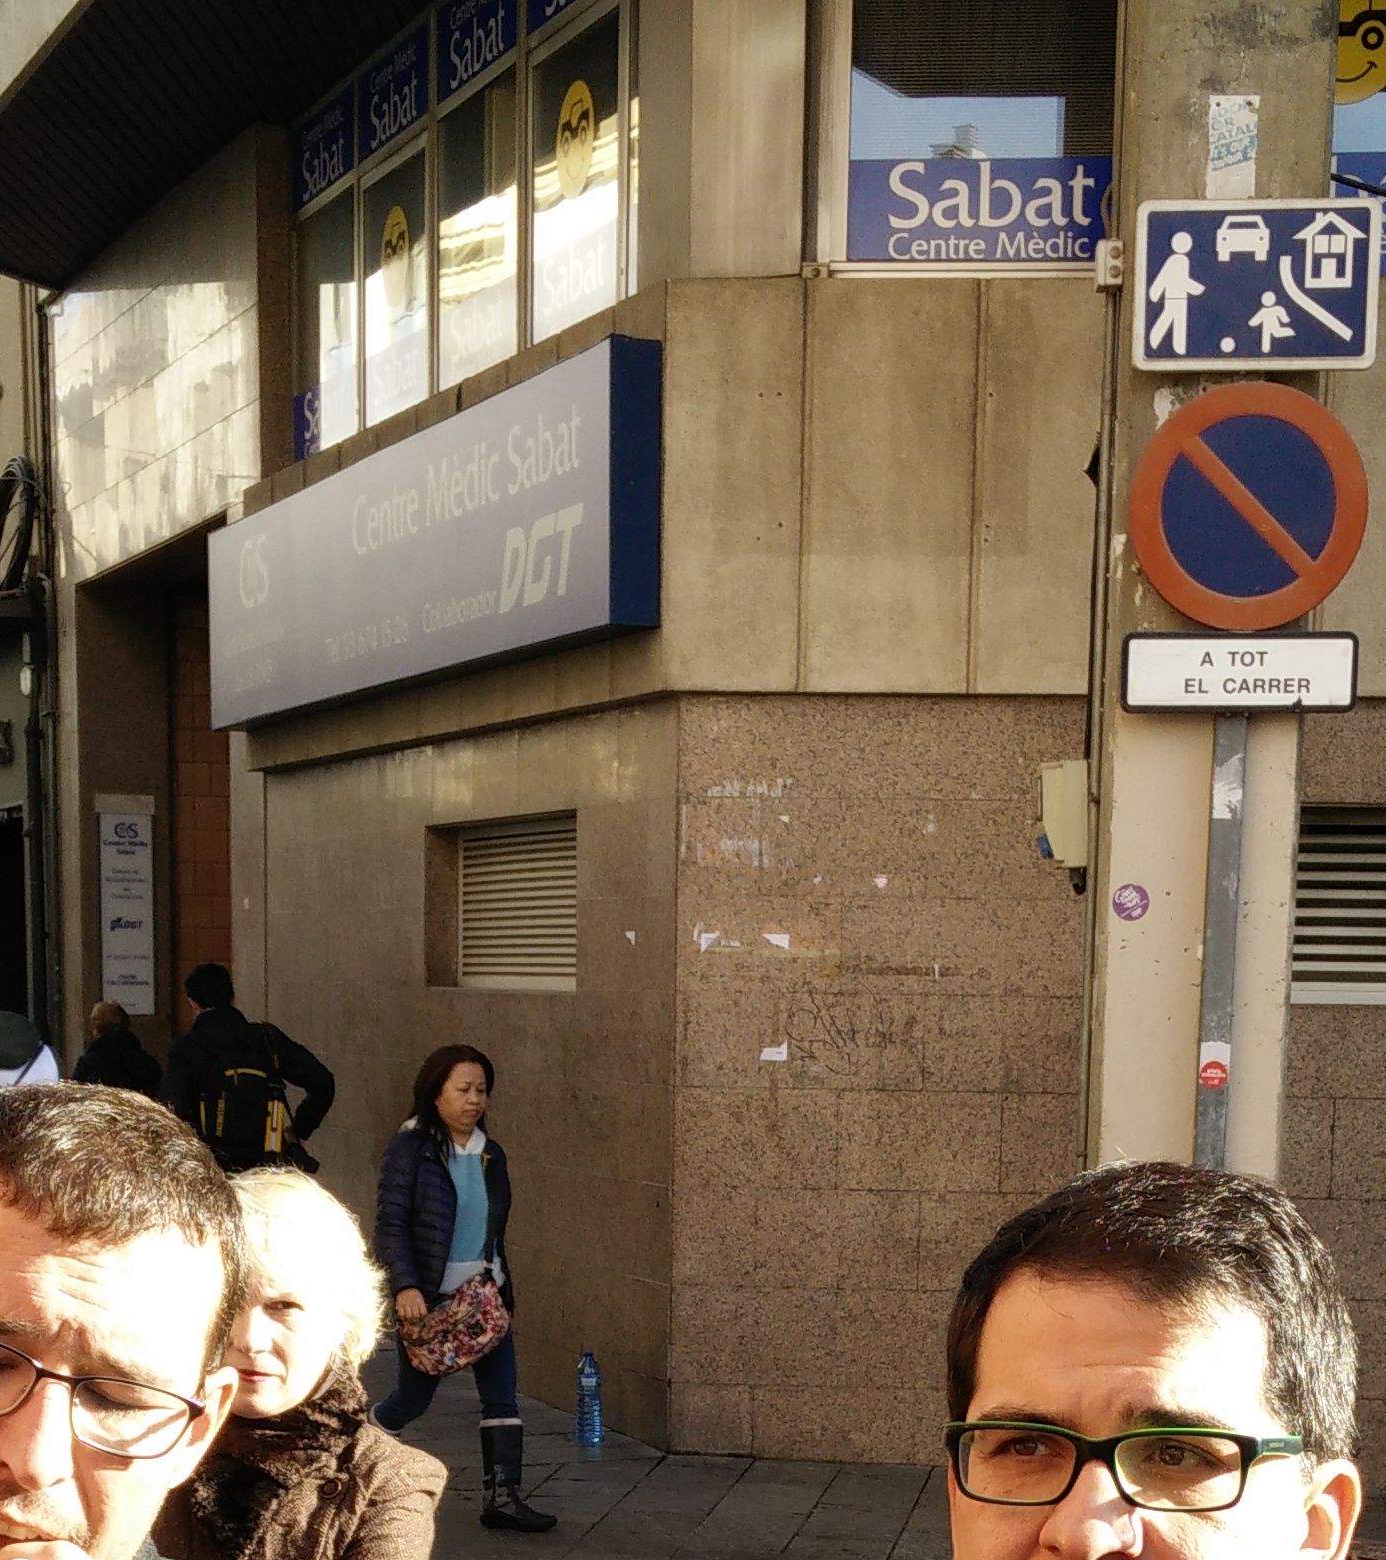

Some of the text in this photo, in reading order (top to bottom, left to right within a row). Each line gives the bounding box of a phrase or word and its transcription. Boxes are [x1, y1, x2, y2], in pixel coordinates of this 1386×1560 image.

[450, 1, 505, 90] Sabat
[370, 70, 417, 149] Sabat
[302, 131, 344, 201] Sabat
[888, 161, 1095, 228] Sabat
[542, 241, 606, 317] Sabat
[888, 231, 1090, 260] Centre Mèdic
[352, 402, 582, 555] Centre Mèdic Sabat
[499, 502, 584, 613] DGT
[1183, 677, 1311, 695] EL CARRER
[1200, 650, 1269, 668] A TOT
